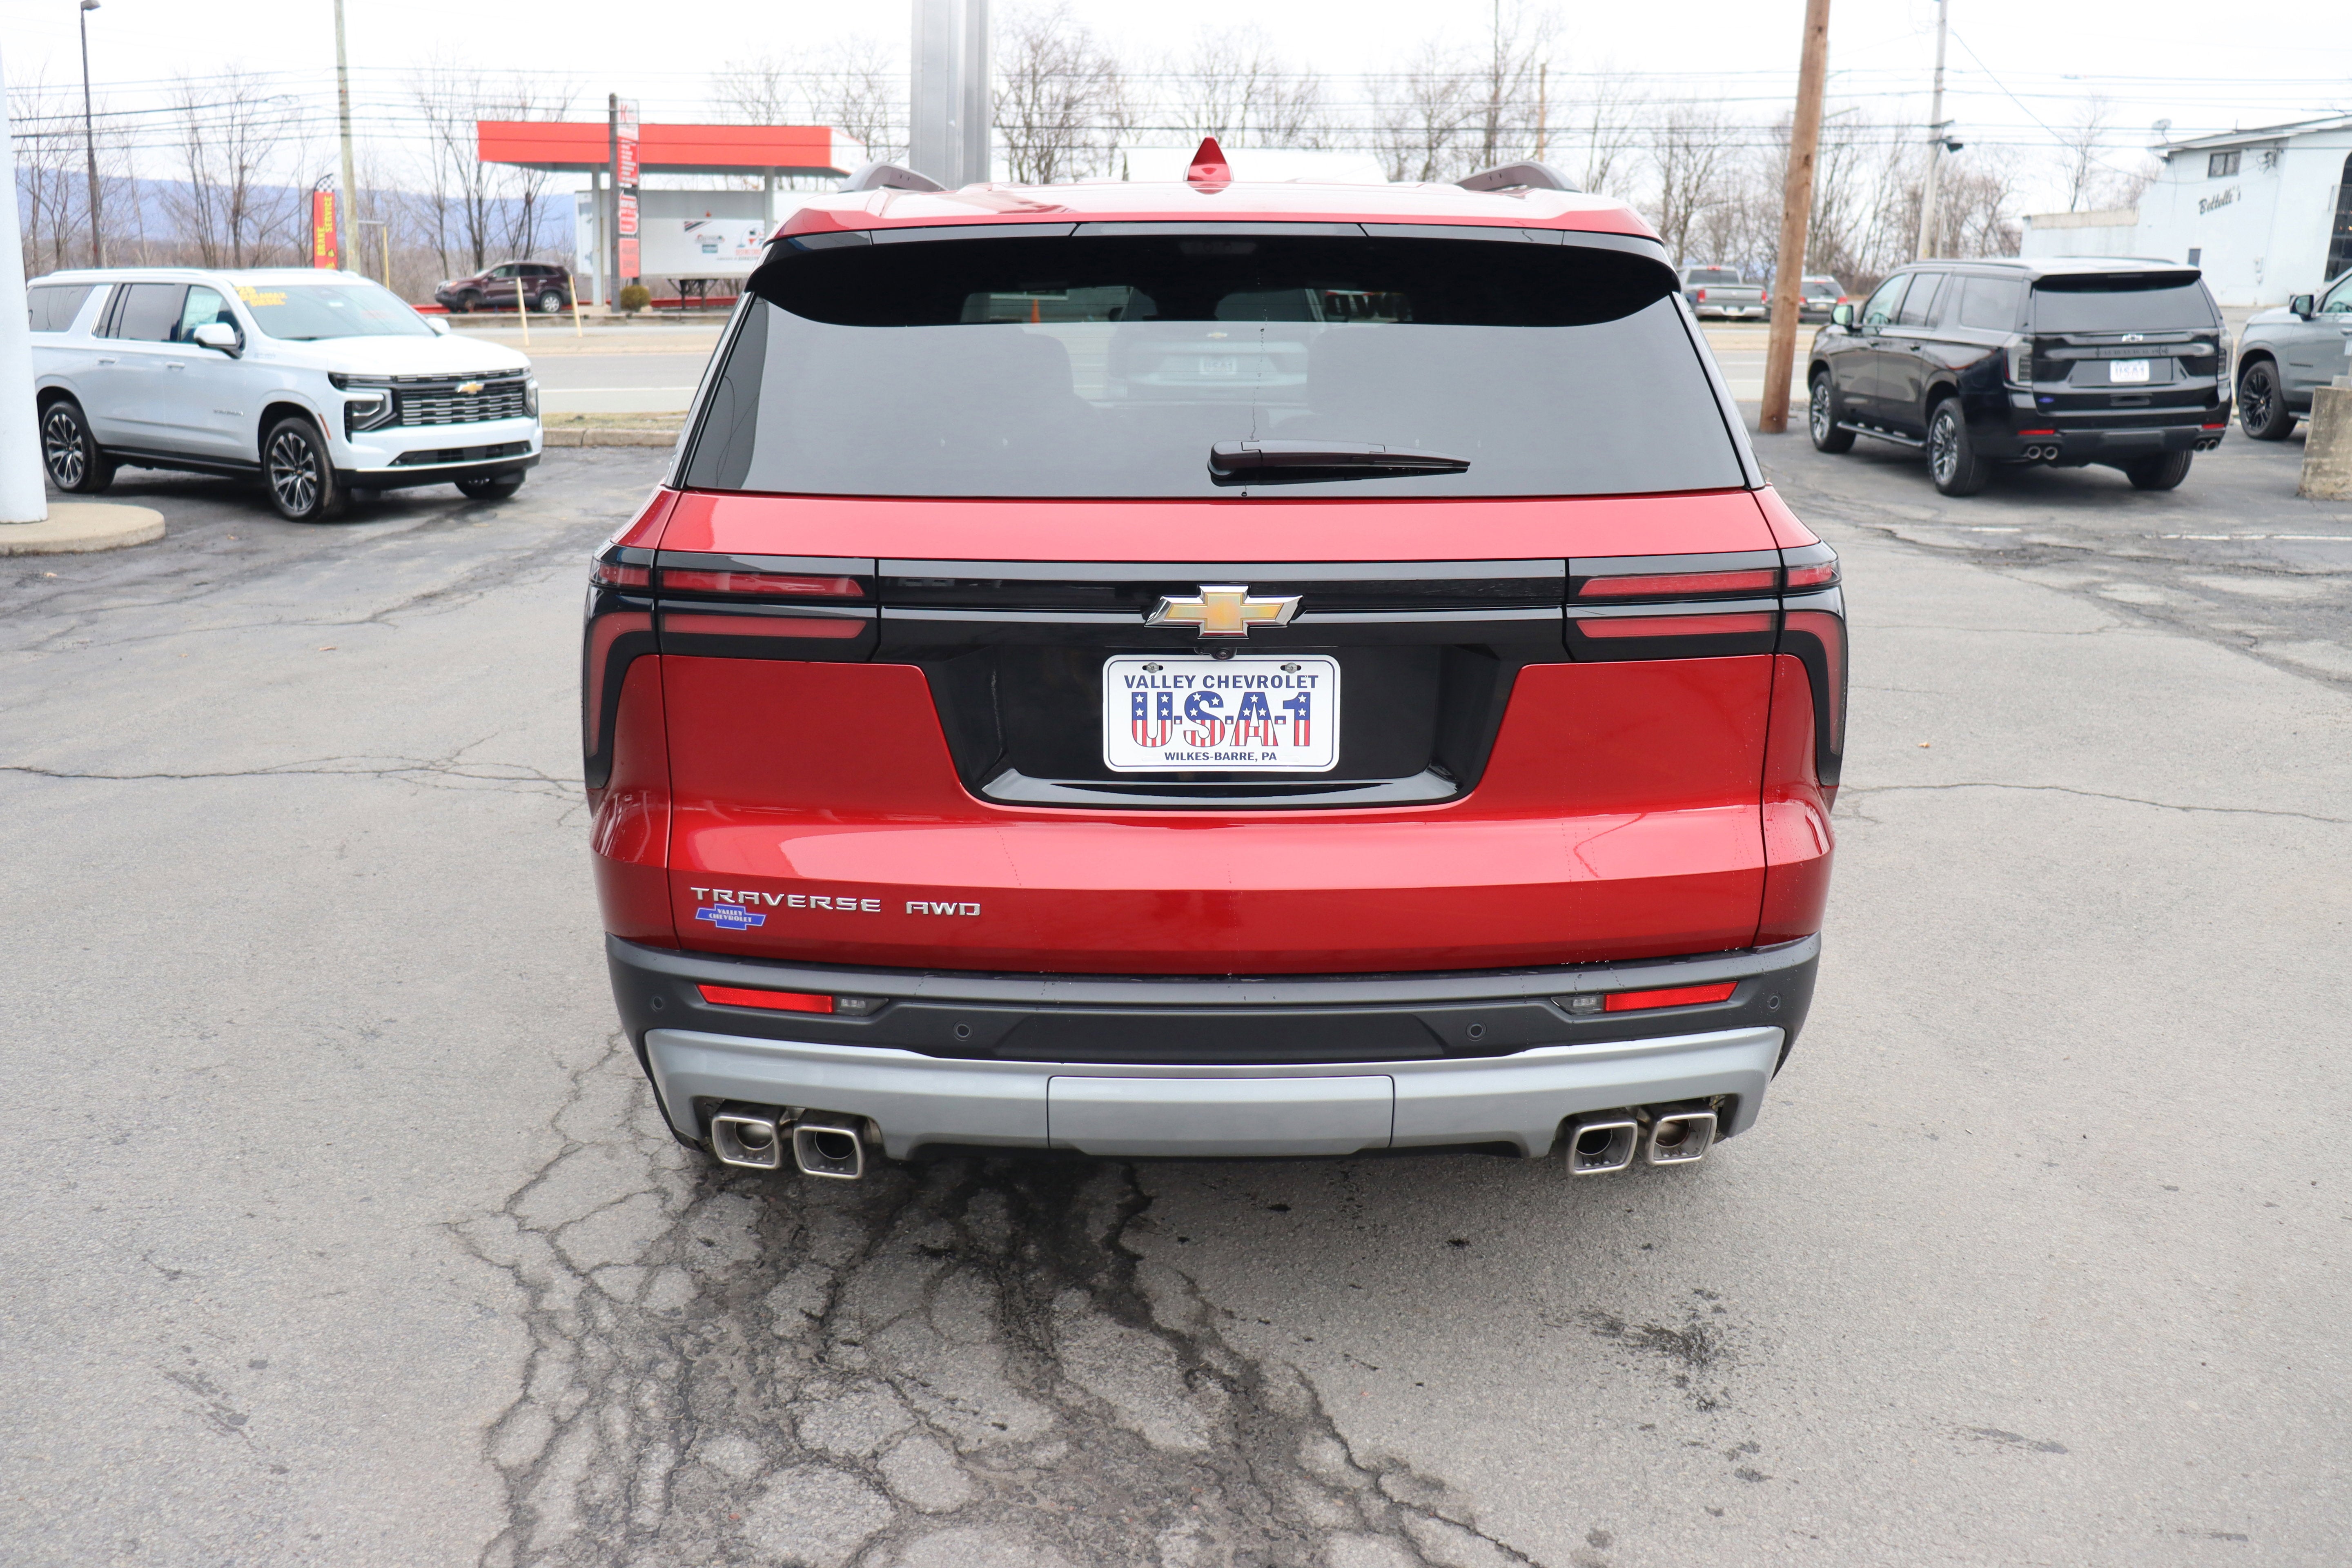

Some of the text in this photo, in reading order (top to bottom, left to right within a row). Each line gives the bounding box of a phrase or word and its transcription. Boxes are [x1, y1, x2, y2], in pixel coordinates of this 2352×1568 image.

[324, 196, 332, 233] SERVICE
[1124, 675, 1319, 689] VALLEY CHEVROLET
[1164, 752, 1277, 762] WILKES-BARRE, PA
[690, 886, 981, 916] TRAVERSE AWD
[709, 913, 752, 922] CHEVROLET
